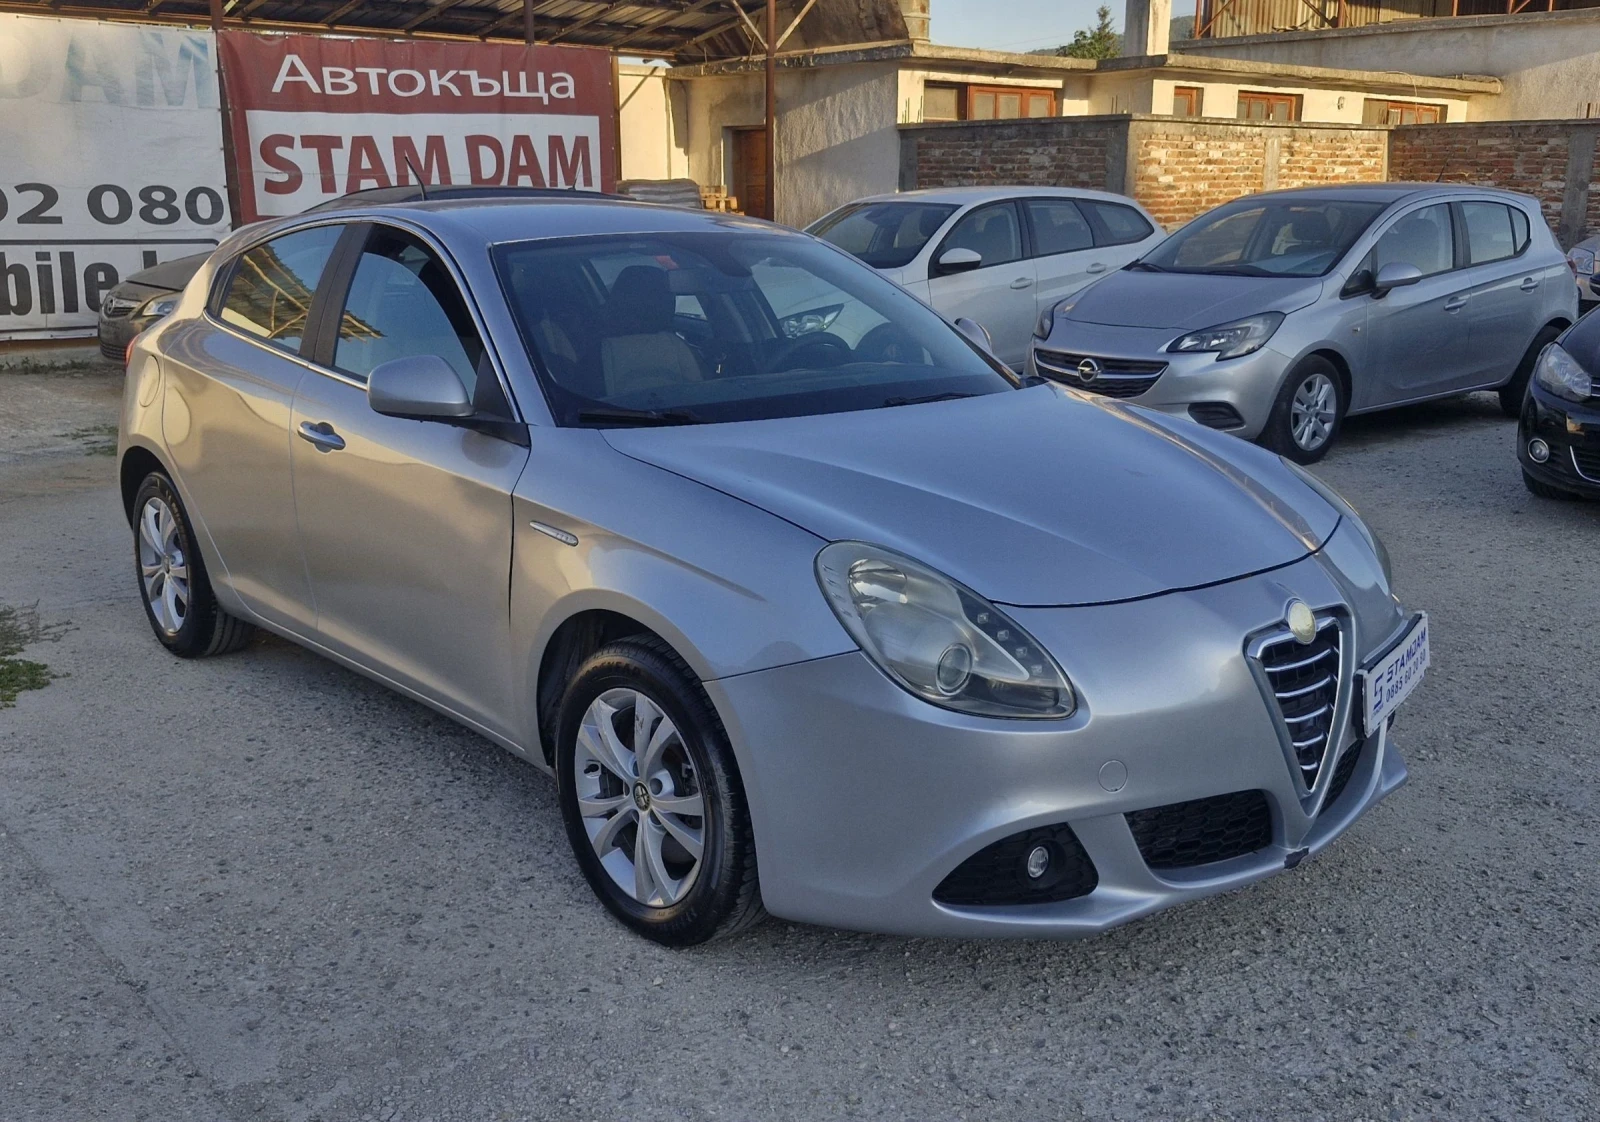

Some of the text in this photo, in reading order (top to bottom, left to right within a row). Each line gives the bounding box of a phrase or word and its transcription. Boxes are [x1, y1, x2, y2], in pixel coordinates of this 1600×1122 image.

[272, 54, 575, 104] Автокъща
[259, 134, 593, 195] STAM DAM
[0, 182, 224, 226] 2 080
[1386, 676, 1403, 703] 0885
